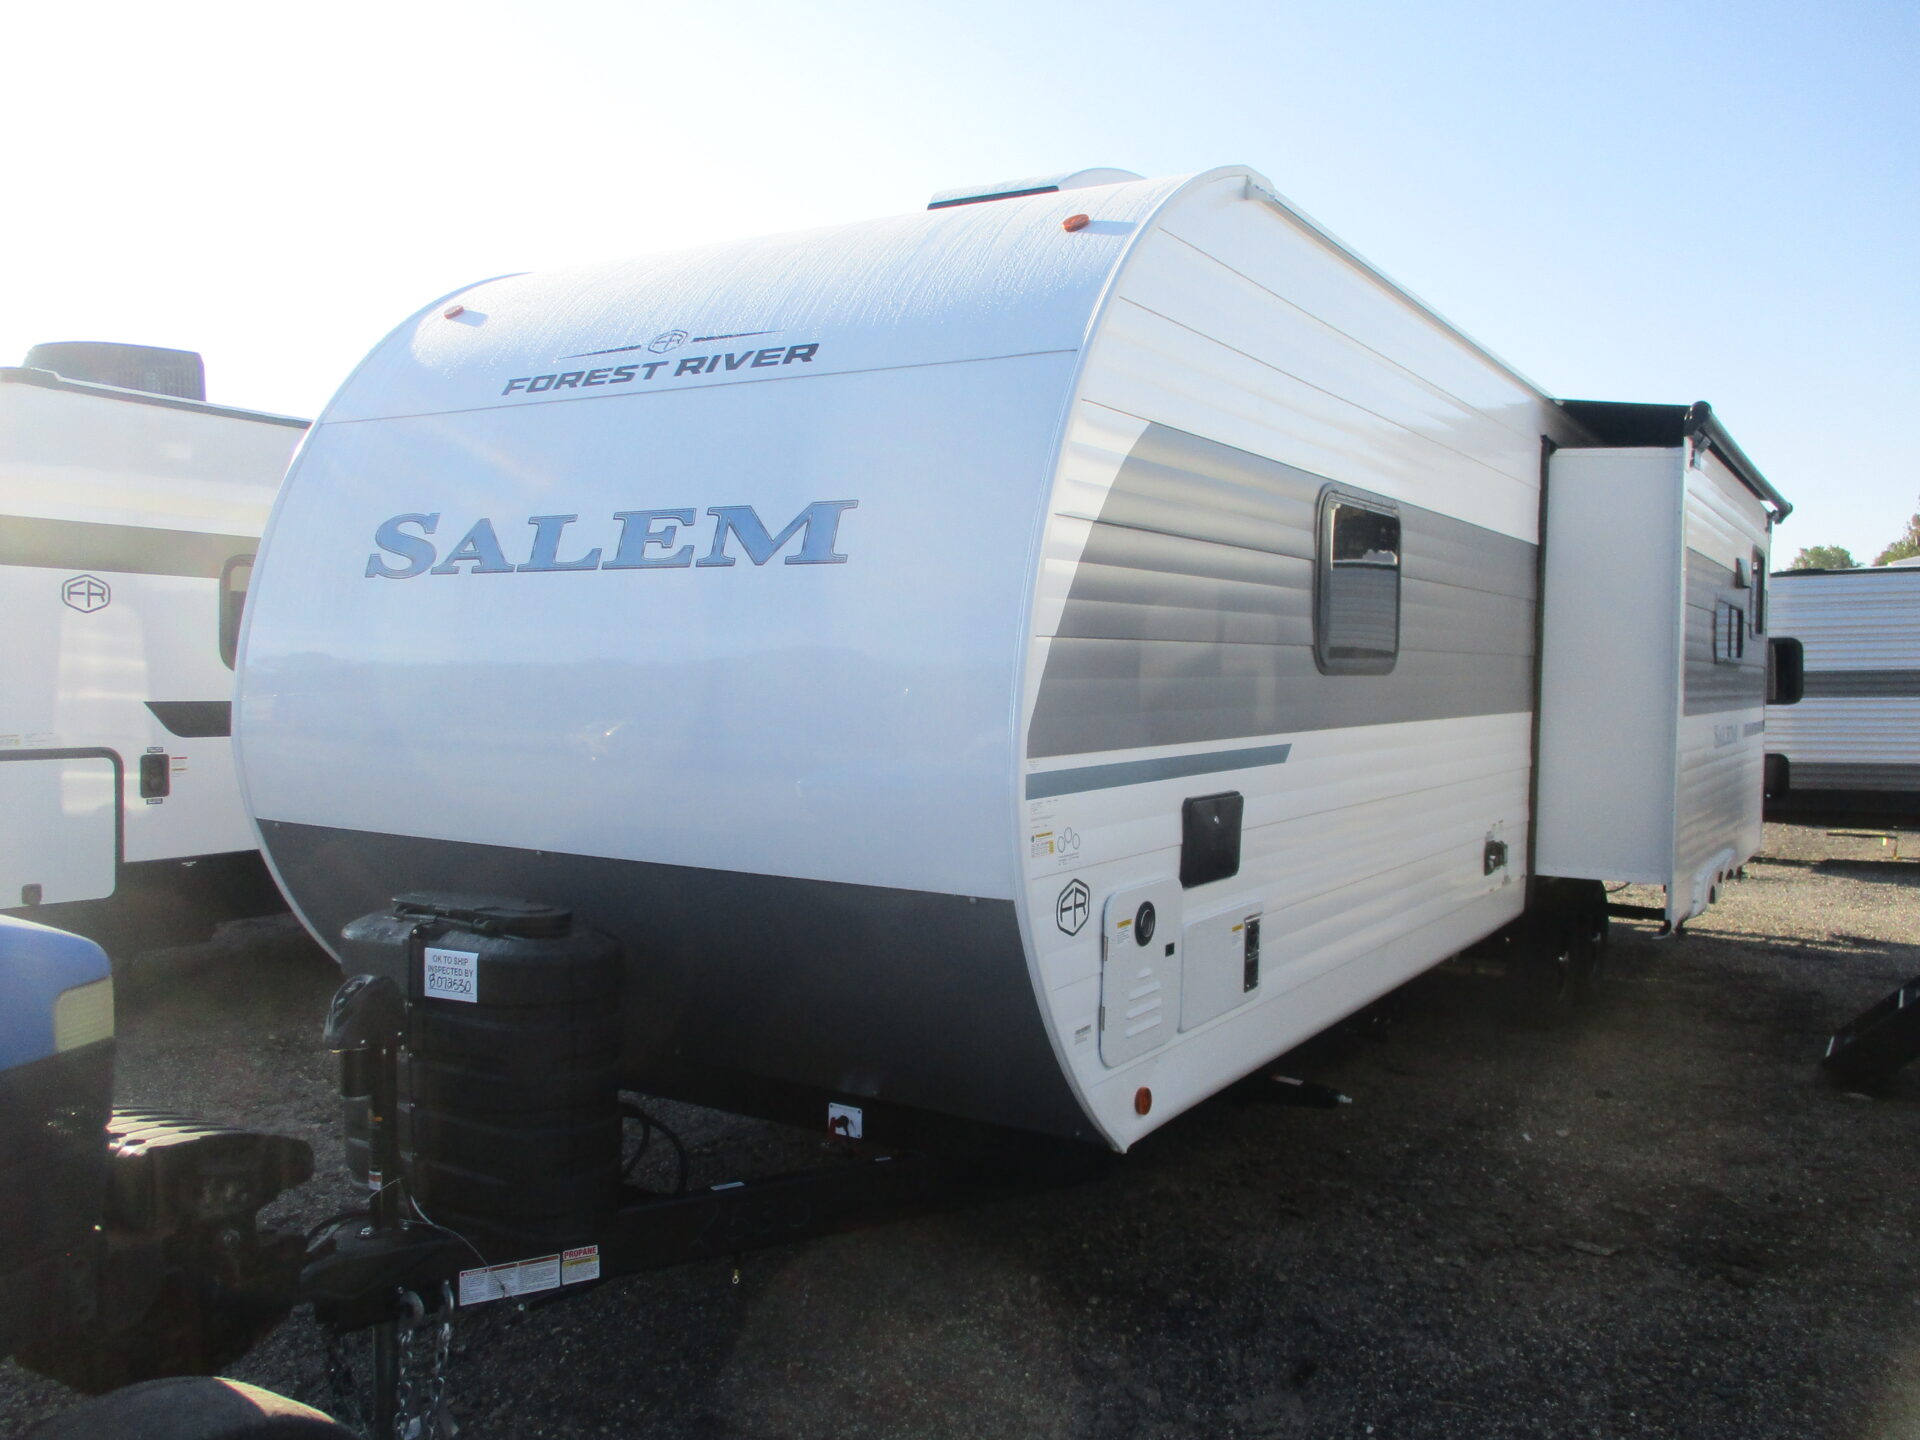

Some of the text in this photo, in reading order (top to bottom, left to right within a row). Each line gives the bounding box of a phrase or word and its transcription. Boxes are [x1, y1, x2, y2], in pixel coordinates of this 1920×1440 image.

[501, 342, 820, 396] FOREST RIVER
[364, 499, 860, 580] SALEM
[1060, 886, 1088, 929] FR
[427, 964, 474, 978] INSPECTED BY
[432, 954, 469, 966] OK TO SHIP
[564, 1246, 597, 1259] PROPANE
